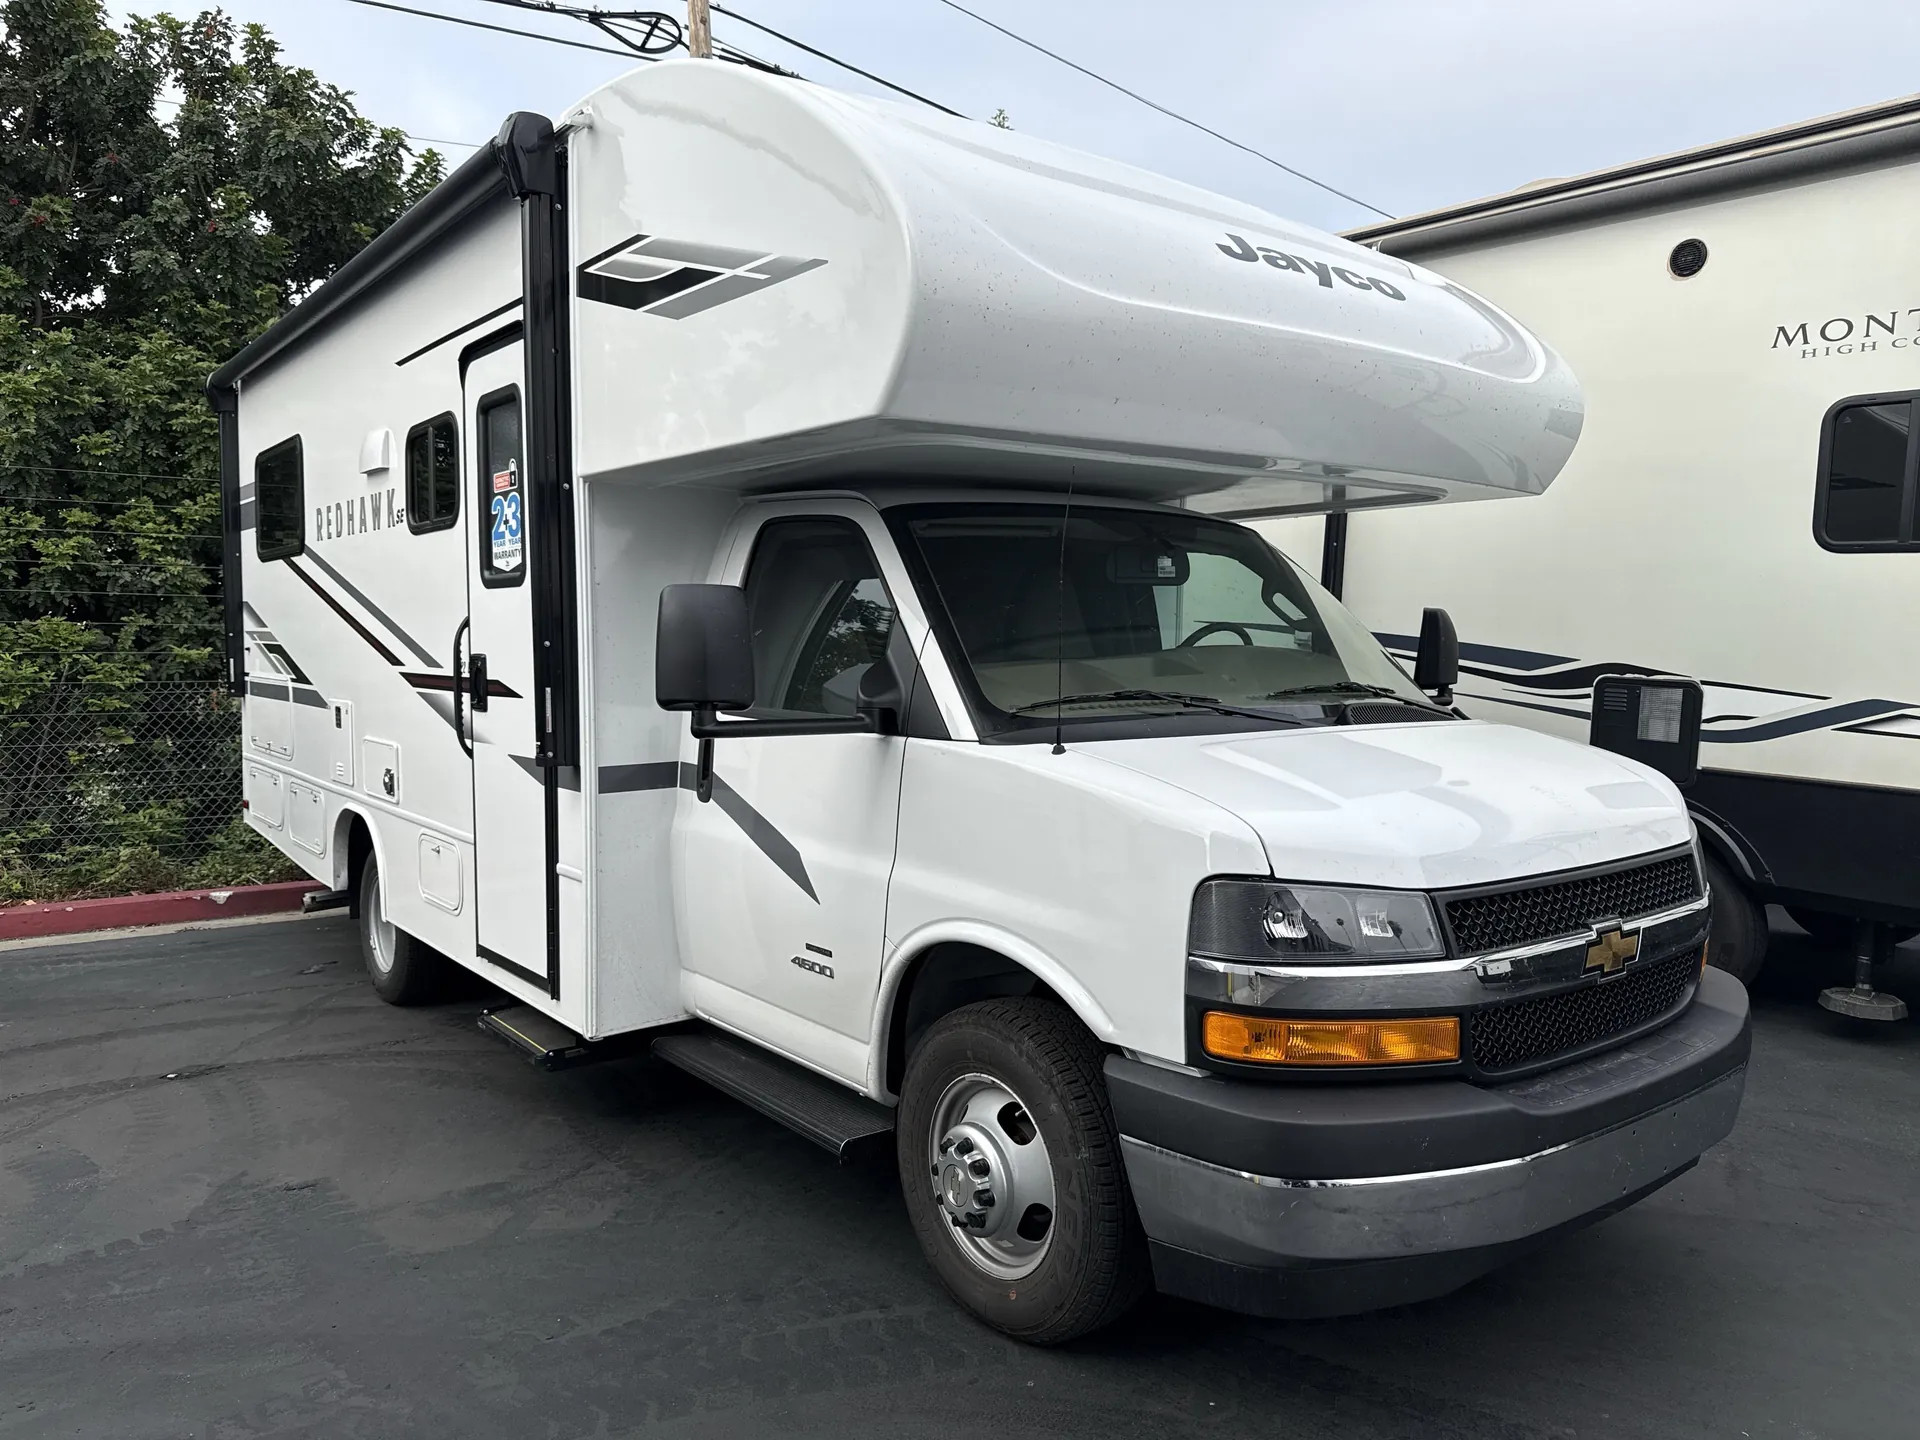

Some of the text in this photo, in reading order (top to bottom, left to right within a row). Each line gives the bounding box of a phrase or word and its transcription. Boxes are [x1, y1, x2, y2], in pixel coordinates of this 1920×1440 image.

[1215, 232, 1407, 301] Jayco
[1800, 340, 1878, 359] HIGH
[316, 488, 404, 542] REDHAWK SE
[494, 540, 506, 548] YEAR
[508, 537, 521, 546] YEAR
[494, 549, 521, 560] WARRANTY
[791, 956, 834, 979] 4500
